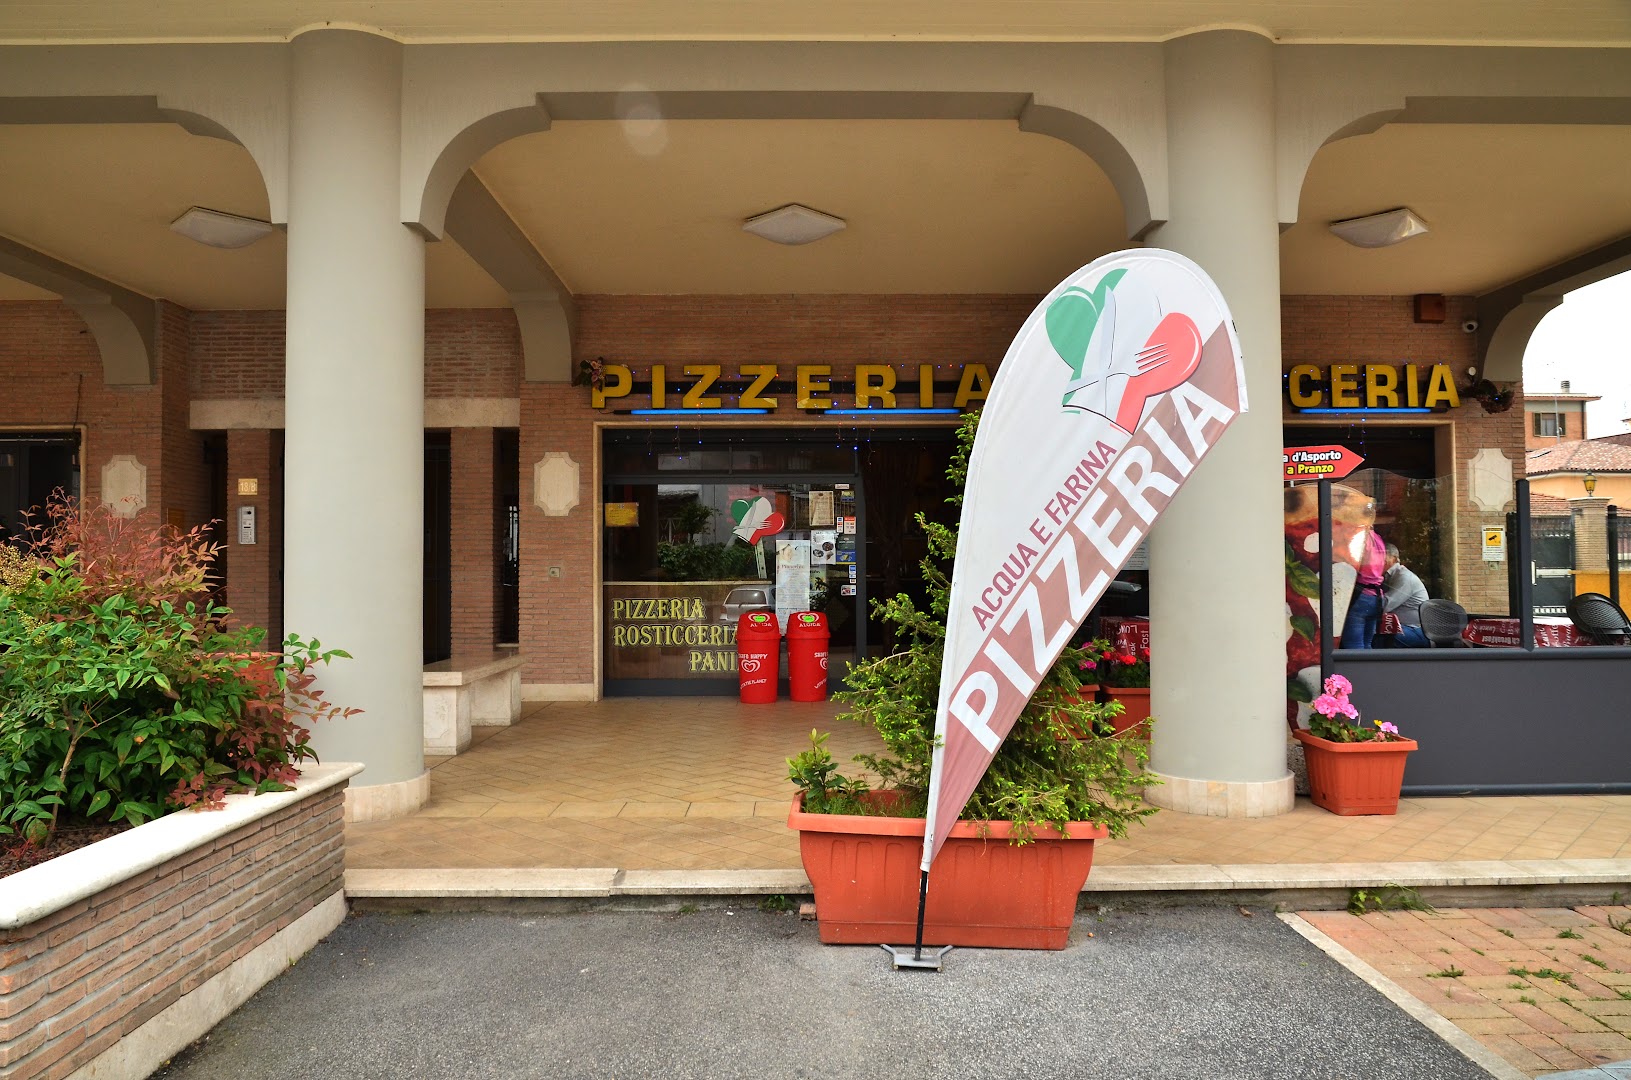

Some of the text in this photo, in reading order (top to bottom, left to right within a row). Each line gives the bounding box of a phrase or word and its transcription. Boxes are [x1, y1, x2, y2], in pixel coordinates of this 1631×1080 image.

[591, 364, 993, 408] PIZZERIA
[1289, 364, 1461, 408] CERIA
[1292, 450, 1342, 464] d'Asporto
[1297, 464, 1334, 474] Pranzo
[972, 440, 1117, 631] ACQUA E FARINA
[949, 381, 1235, 754] PIZZERIA
[612, 598, 705, 620] PIZZERIA
[690, 650, 739, 671] PANI
